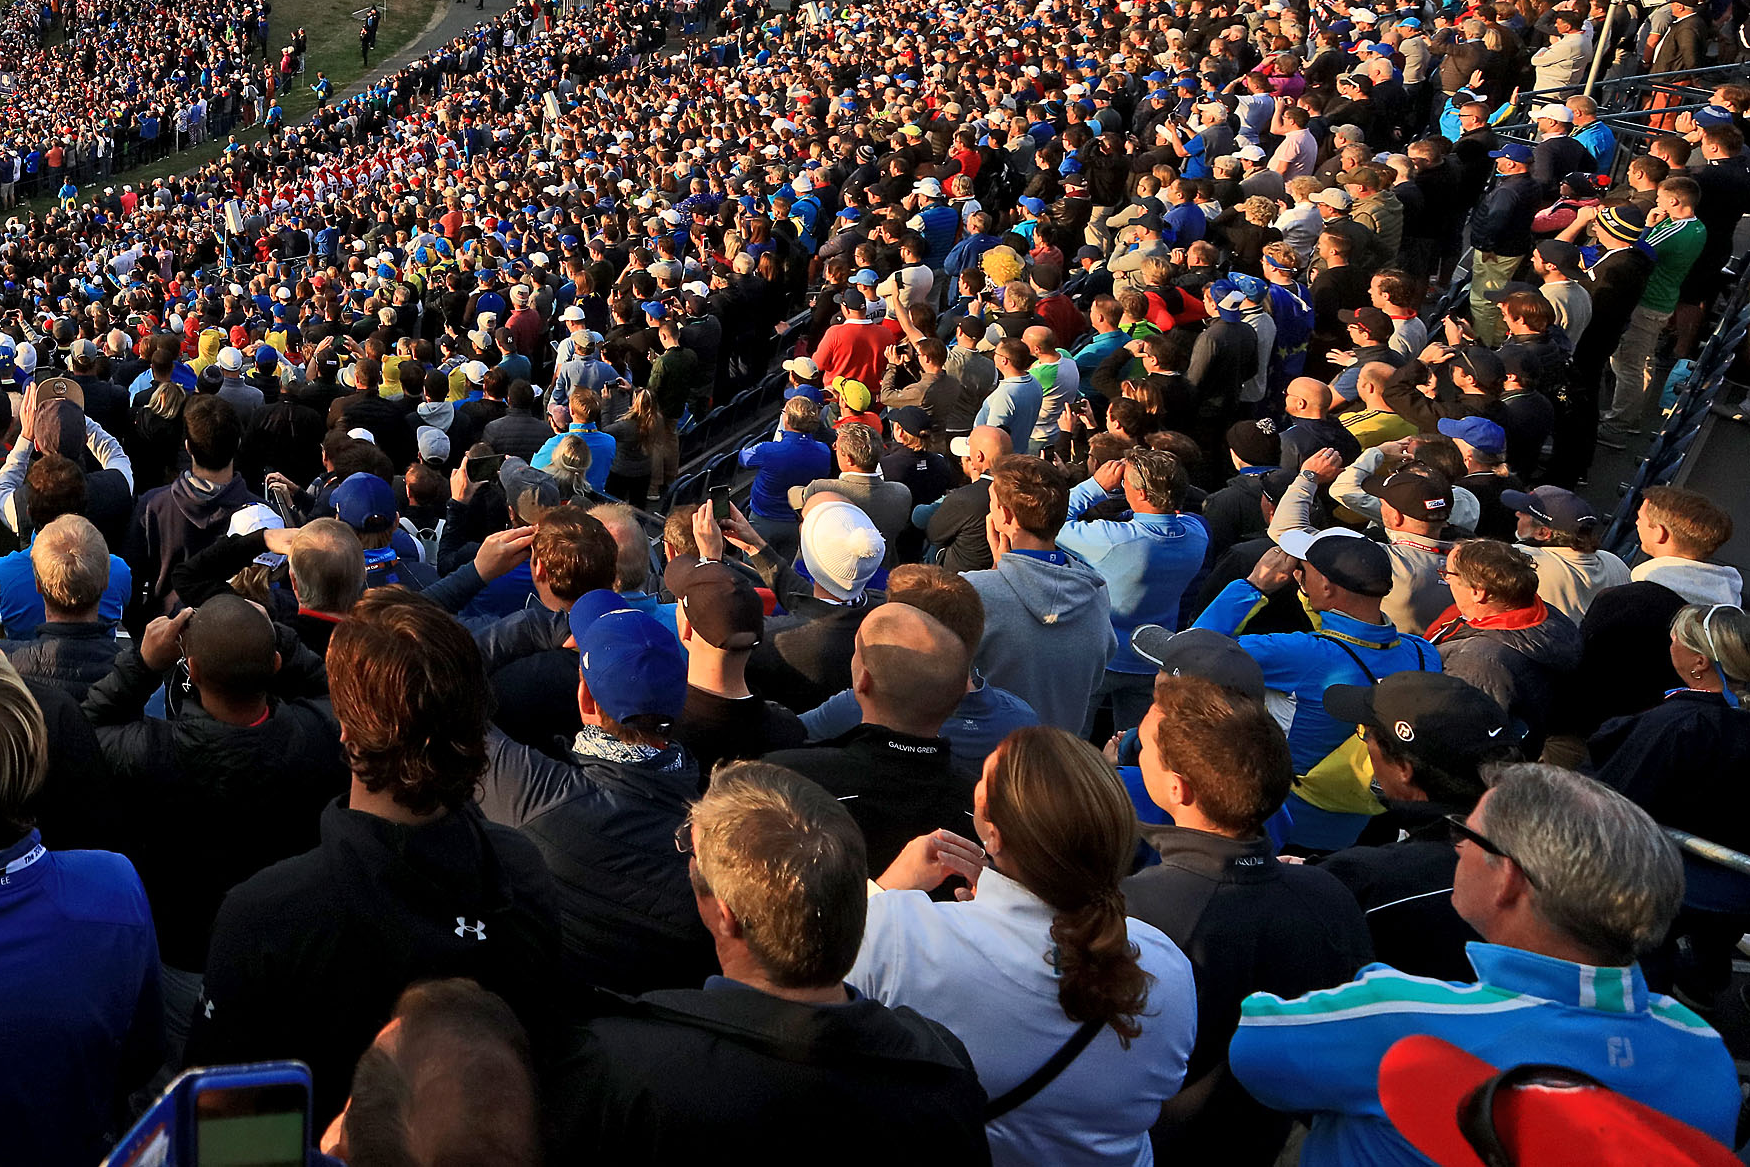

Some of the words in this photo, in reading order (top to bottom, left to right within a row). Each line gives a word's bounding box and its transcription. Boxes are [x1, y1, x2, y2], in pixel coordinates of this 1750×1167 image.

[888, 741, 916, 753] GALVIN
[917, 746, 938, 754] GREEN
[24, 855, 35, 864] The
